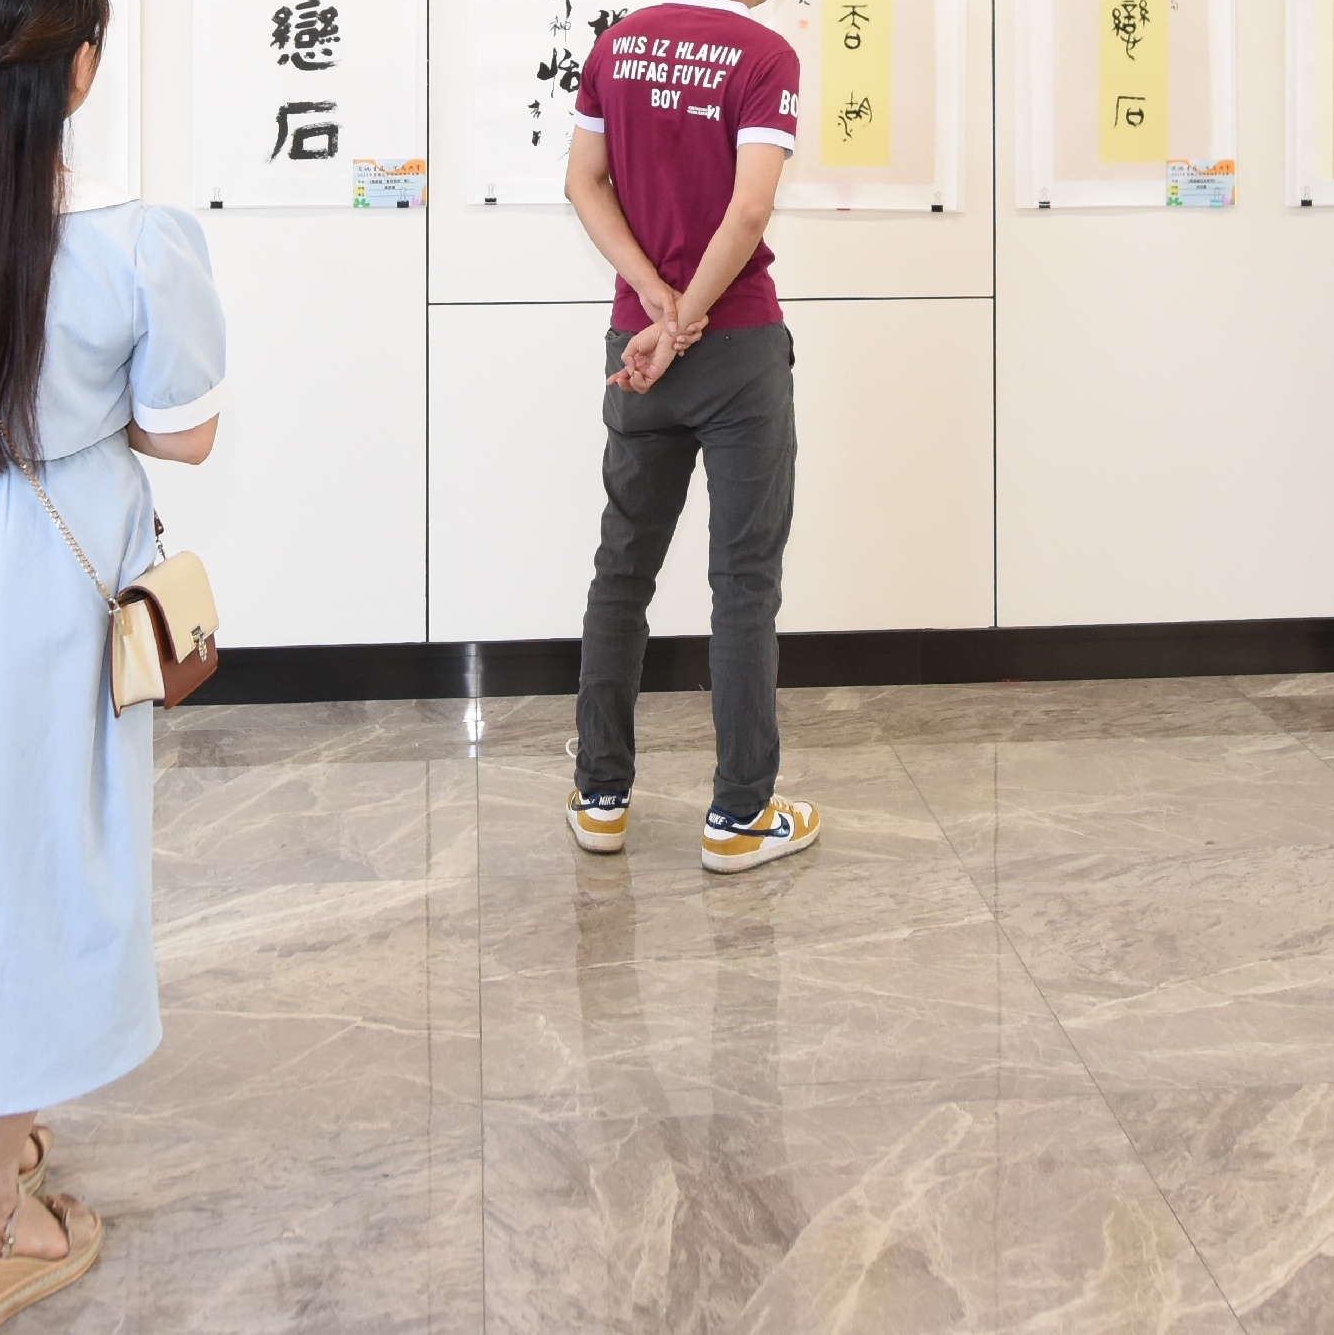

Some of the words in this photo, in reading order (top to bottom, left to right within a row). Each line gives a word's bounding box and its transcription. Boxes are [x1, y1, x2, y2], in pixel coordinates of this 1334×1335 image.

[612, 36, 647, 55] VNIS
[652, 39, 671, 57] IZ
[675, 42, 742, 67] HLAVIN
[613, 60, 669, 83] LNIFAG
[672, 65, 726, 89] FUYLF
[651, 89, 681, 110] BOY
[598, 795, 617, 806] NIKE
[708, 812, 725, 826] NIKE
